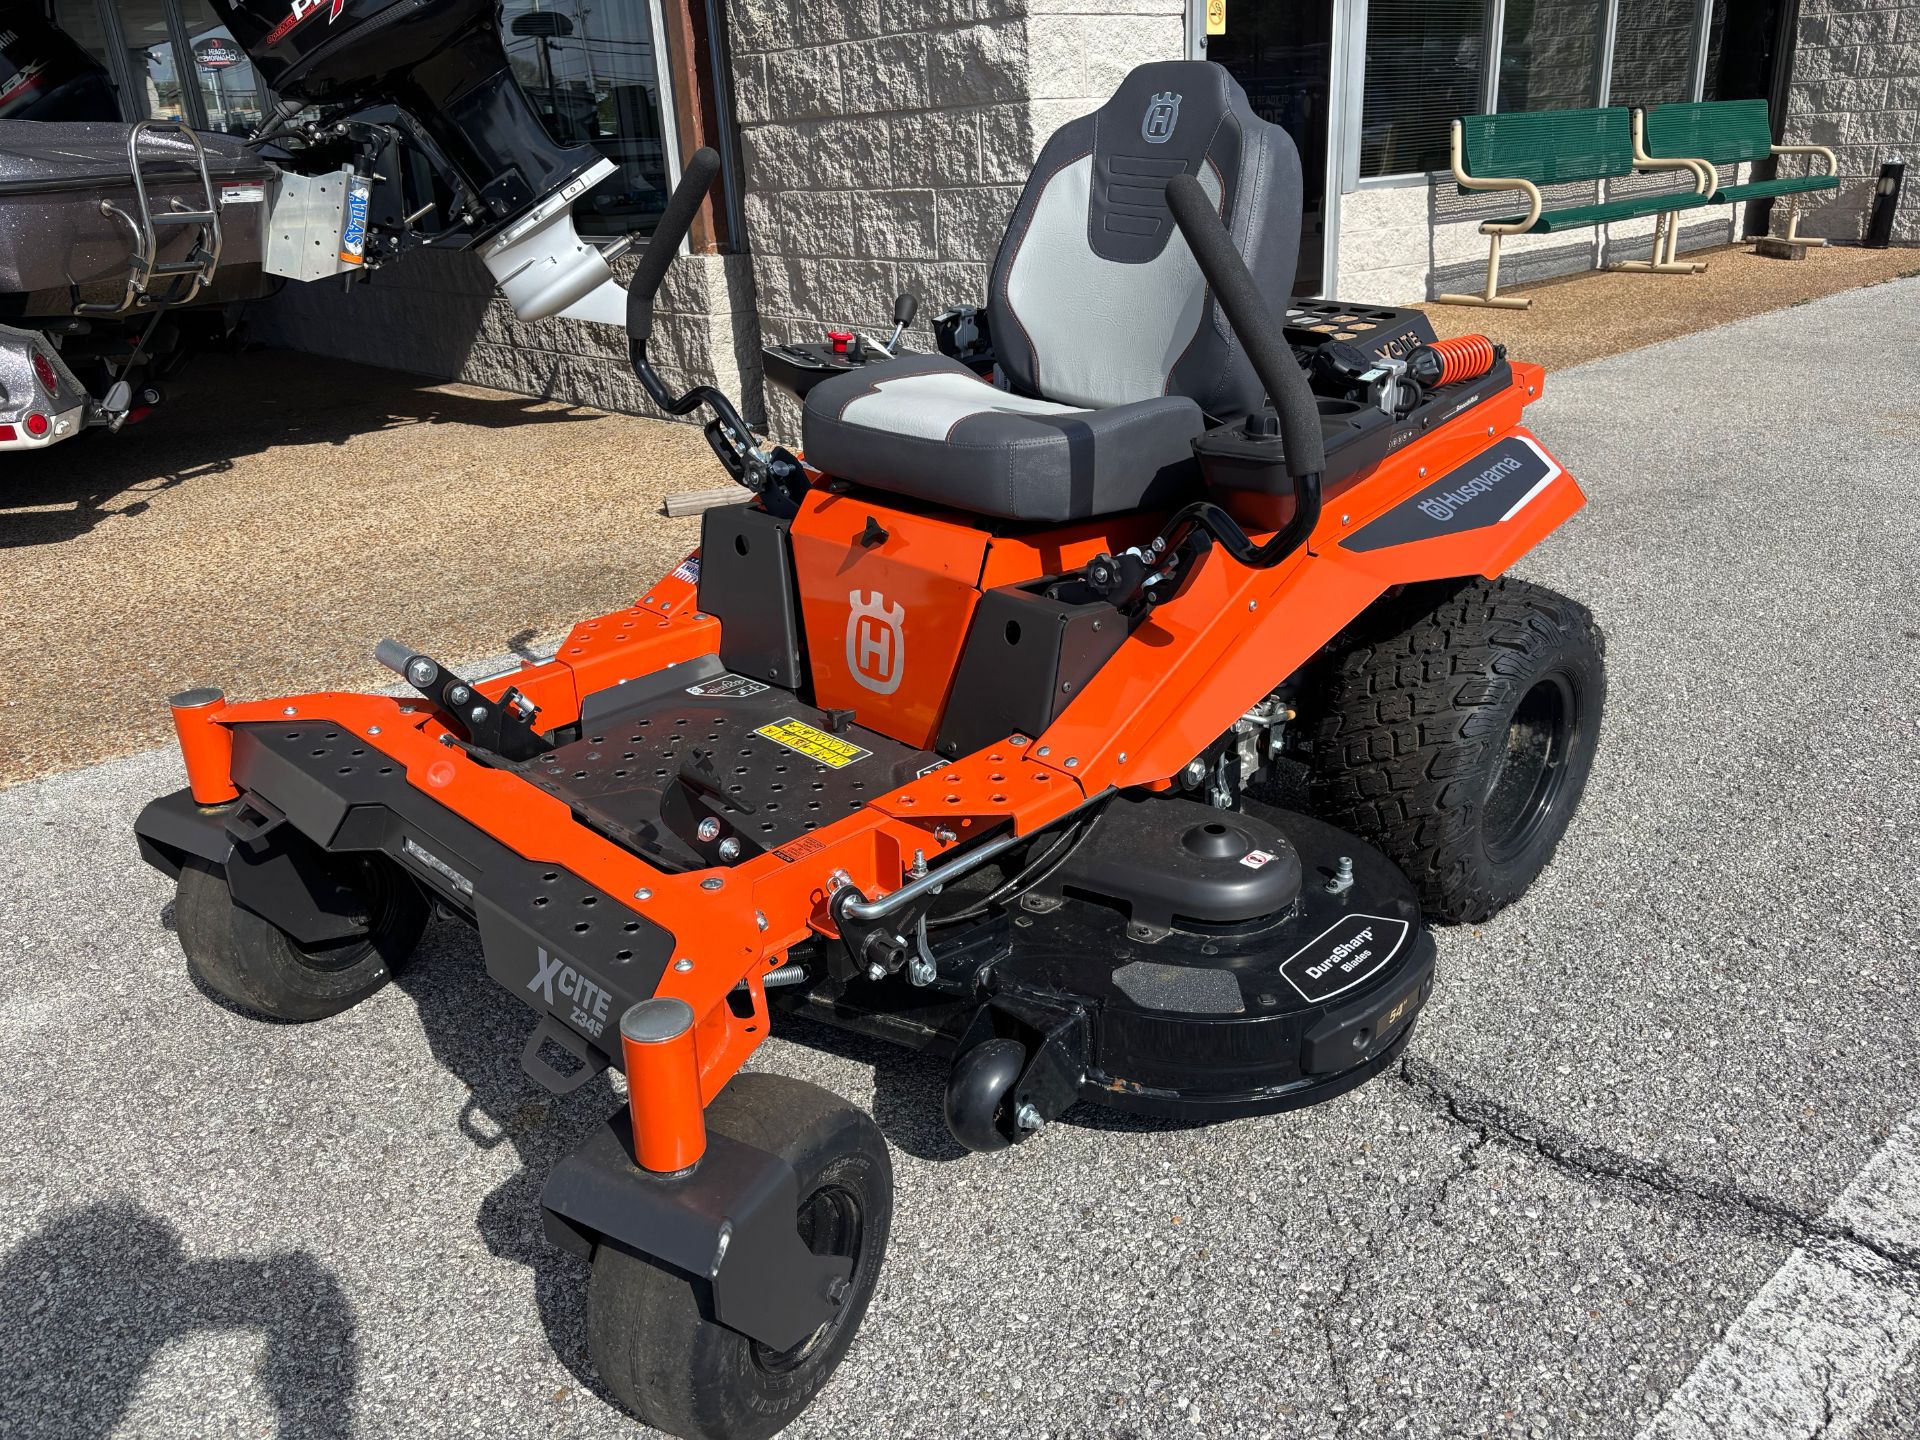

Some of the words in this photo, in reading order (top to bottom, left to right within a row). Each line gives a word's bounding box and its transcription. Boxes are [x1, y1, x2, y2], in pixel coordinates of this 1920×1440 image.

[343, 191, 368, 247] ATLAS
[1436, 457, 1523, 510] Husqvarna
[526, 945, 613, 1022] XCITE
[1340, 949, 1372, 973] Blades
[570, 1005, 604, 1039] Z345
